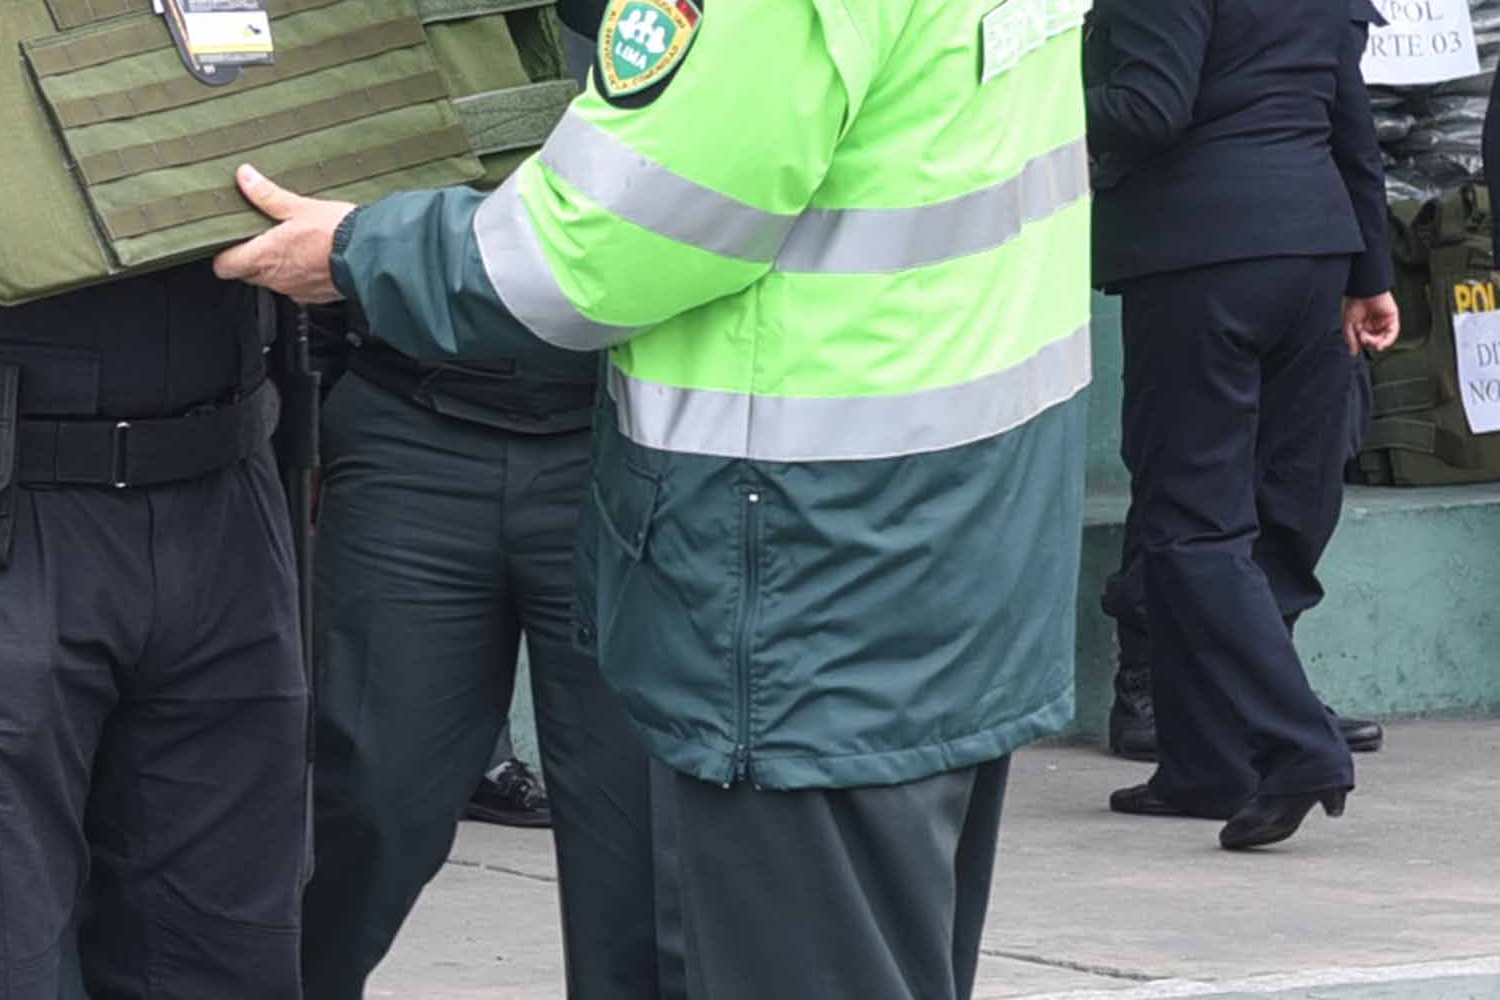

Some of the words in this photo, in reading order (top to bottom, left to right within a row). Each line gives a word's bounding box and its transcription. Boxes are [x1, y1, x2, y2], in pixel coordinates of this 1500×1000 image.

[614, 40, 648, 71] LIMA
[1431, 31, 1463, 56] 03
[1476, 340, 1500, 369] DI
